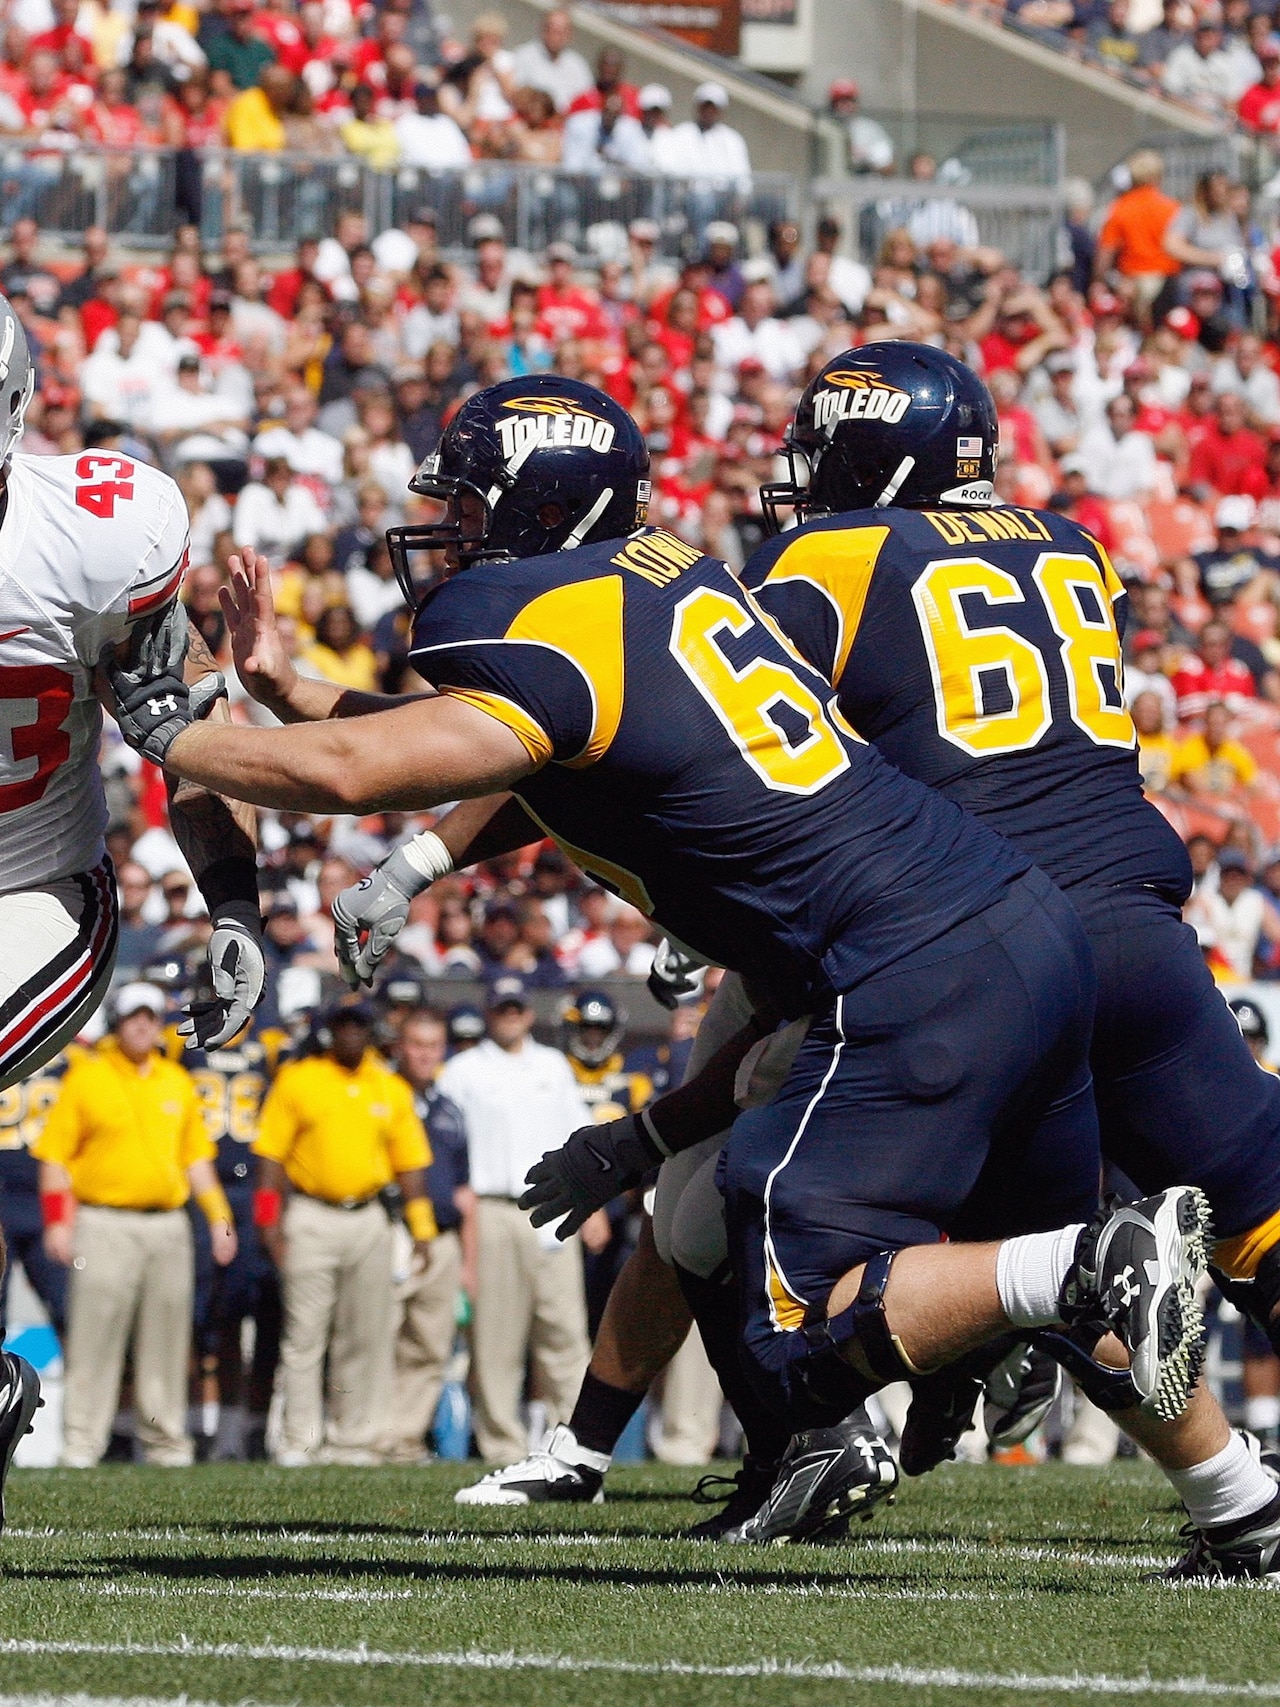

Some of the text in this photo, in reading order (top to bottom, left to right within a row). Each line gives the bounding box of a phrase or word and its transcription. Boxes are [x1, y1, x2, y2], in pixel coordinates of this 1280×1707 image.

[494, 412, 616, 460] TOLEDO
[813, 387, 911, 431] TOLEDO
[74, 455, 135, 519] 43
[921, 507, 1054, 546] DEWALT
[668, 562, 869, 796] 6
[910, 551, 1137, 758] 68
